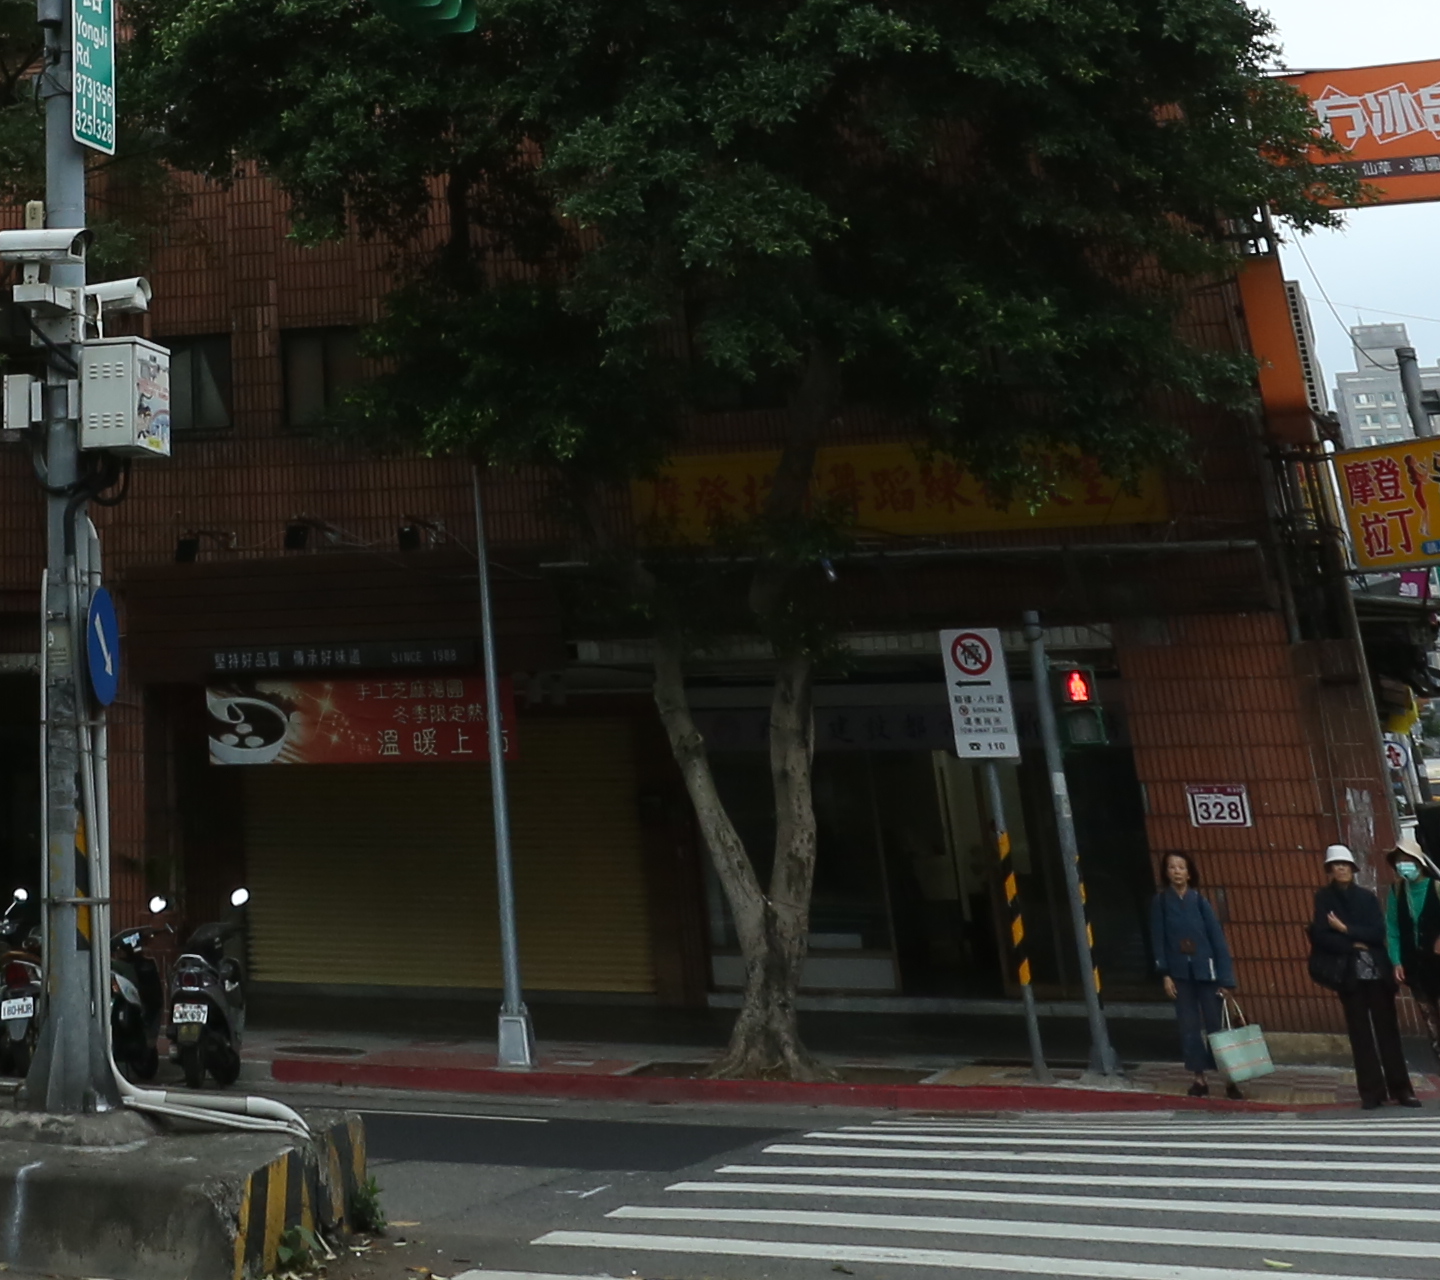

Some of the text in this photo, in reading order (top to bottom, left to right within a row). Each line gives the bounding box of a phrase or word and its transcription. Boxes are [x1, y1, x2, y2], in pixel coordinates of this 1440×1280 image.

[75, 12, 109, 50] YongJi
[76, 42, 93, 70] Rd.
[75, 71, 93, 99] 373
[95, 82, 114, 108] 356
[75, 110, 94, 138] 325
[95, 121, 114, 146] 328
[1342, 457, 1406, 507] 摩登
[1361, 508, 1415, 558] 拉丁
[390, 651, 423, 664] SINCE
[391, 704, 504, 725] 冬季限定熱
[987, 742, 1006, 751] 110
[1198, 801, 1241, 821] 328
